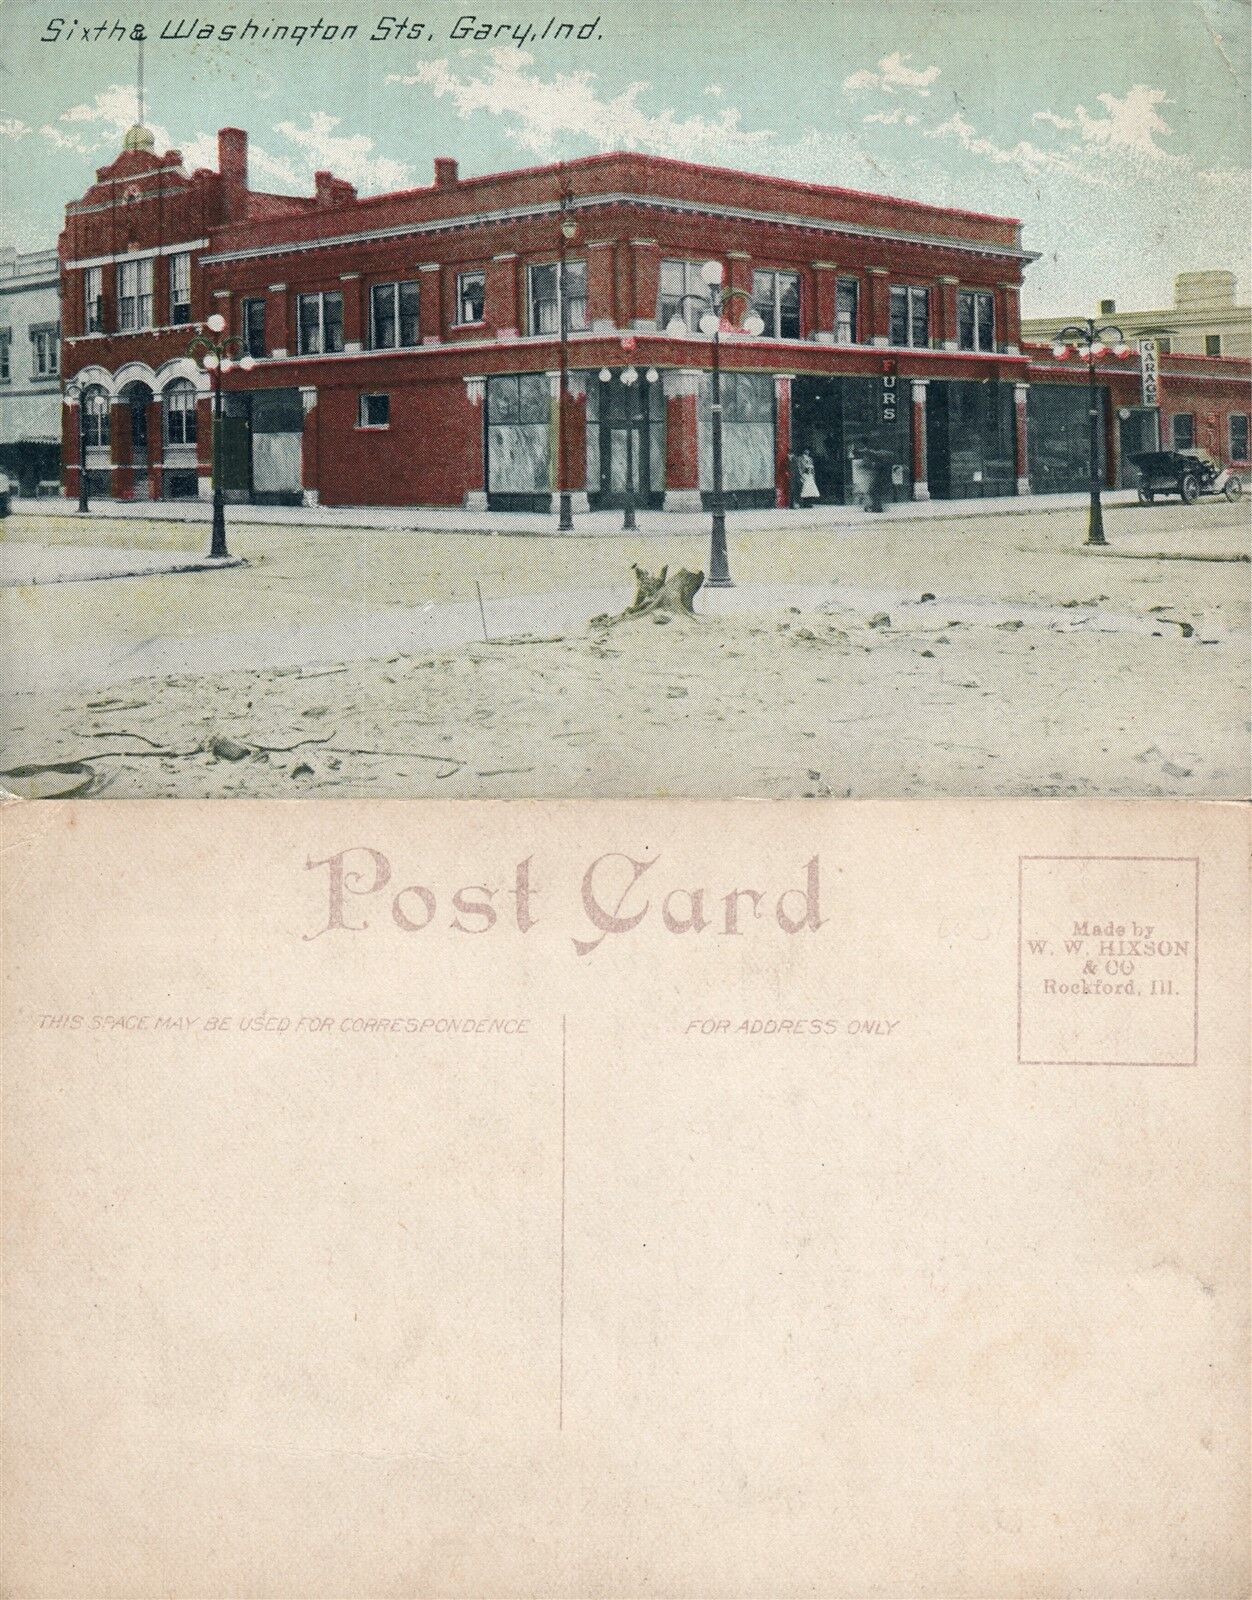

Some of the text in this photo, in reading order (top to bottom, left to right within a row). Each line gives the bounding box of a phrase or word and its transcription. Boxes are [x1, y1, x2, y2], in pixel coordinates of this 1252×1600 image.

[1144, 342, 1157, 403] GARAGE
[882, 359, 896, 420] FURS
[302, 847, 830, 956] Post Card
[1072, 921, 1155, 940] Made by
[1027, 939, 1190, 957] W. W. HIXSON
[1082, 959, 1098, 975] &
[1043, 978, 1180, 997] Rockford, Ill.
[38, 1014, 532, 1034] THIS SPACE MAY BE USED FOR CORRESPONDENCE
[684, 1019, 901, 1035] FOR ADDRESS ONLY
